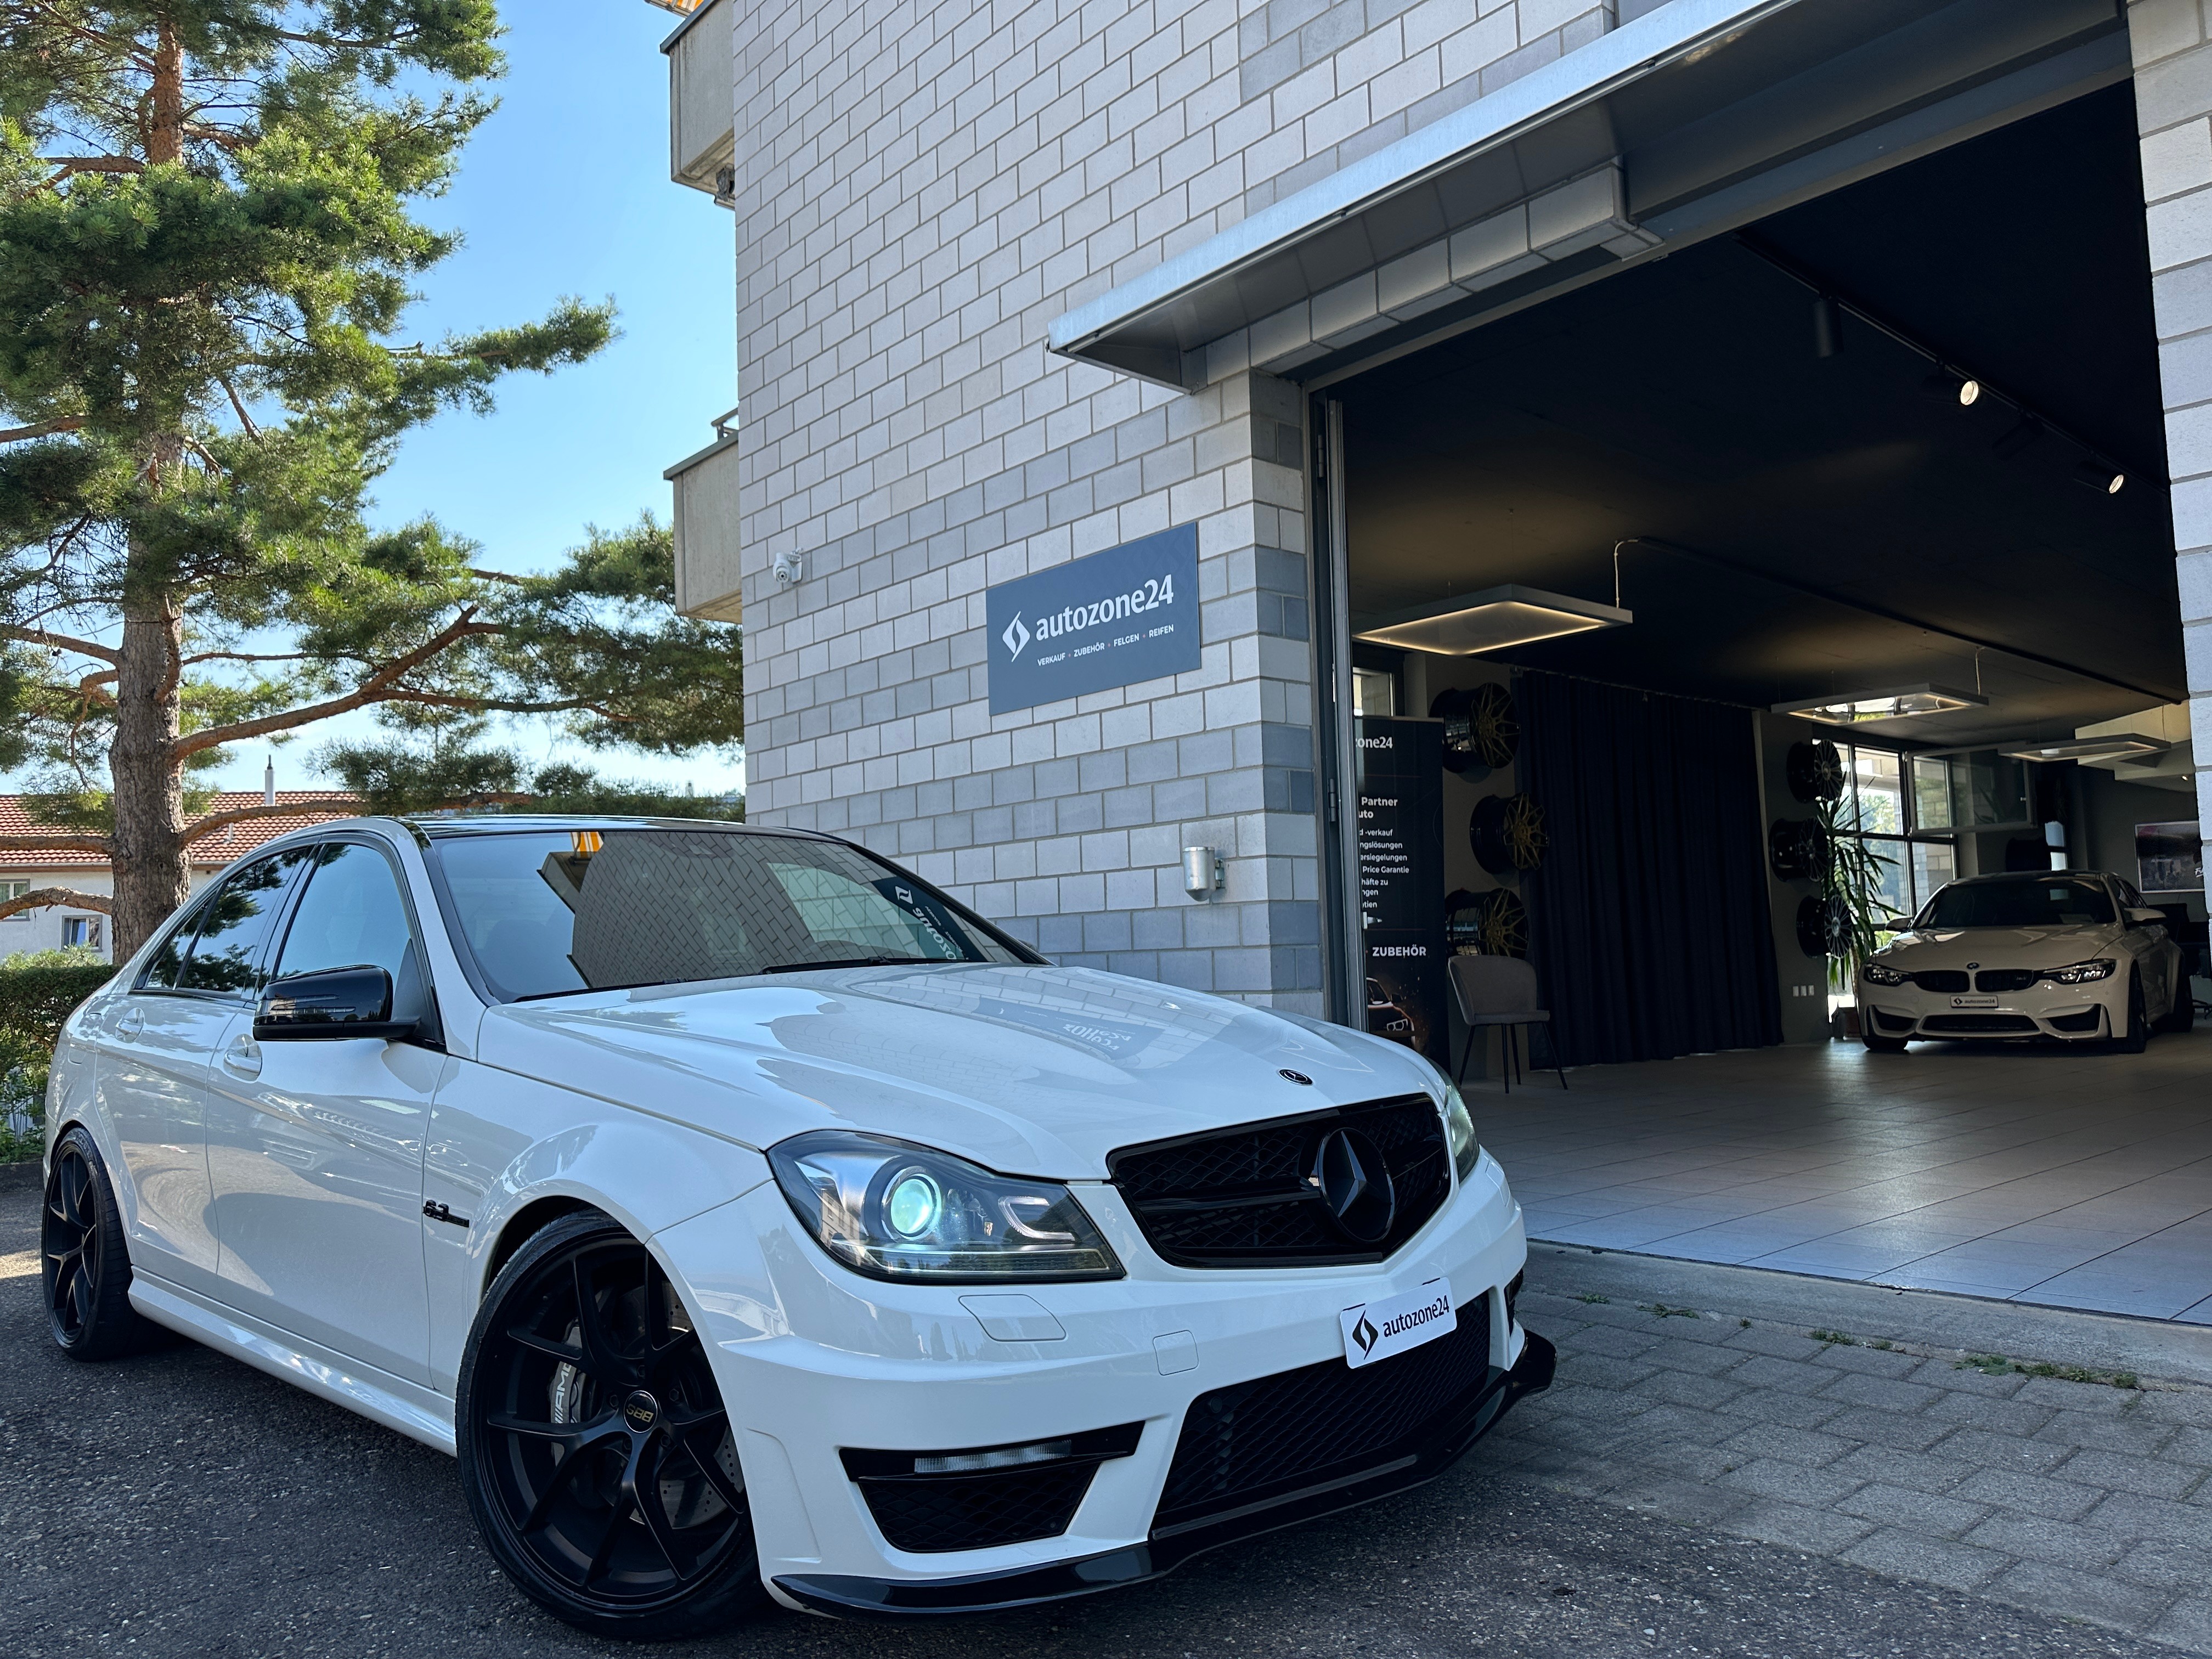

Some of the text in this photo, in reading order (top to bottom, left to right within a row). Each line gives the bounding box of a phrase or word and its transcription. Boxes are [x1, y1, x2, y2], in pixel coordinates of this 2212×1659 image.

[1035, 574, 1174, 641] autozone24
[1037, 624, 1174, 666] VERKAUF ZUBEHÖR FELGEN REIFEN
[1361, 797, 1398, 806] Partner
[1381, 866, 1409, 874] Garantie
[1372, 944, 1426, 957] ZUBEHÖR
[1383, 1295, 1449, 1338] autozone24
[626, 1403, 654, 1423] BBS
